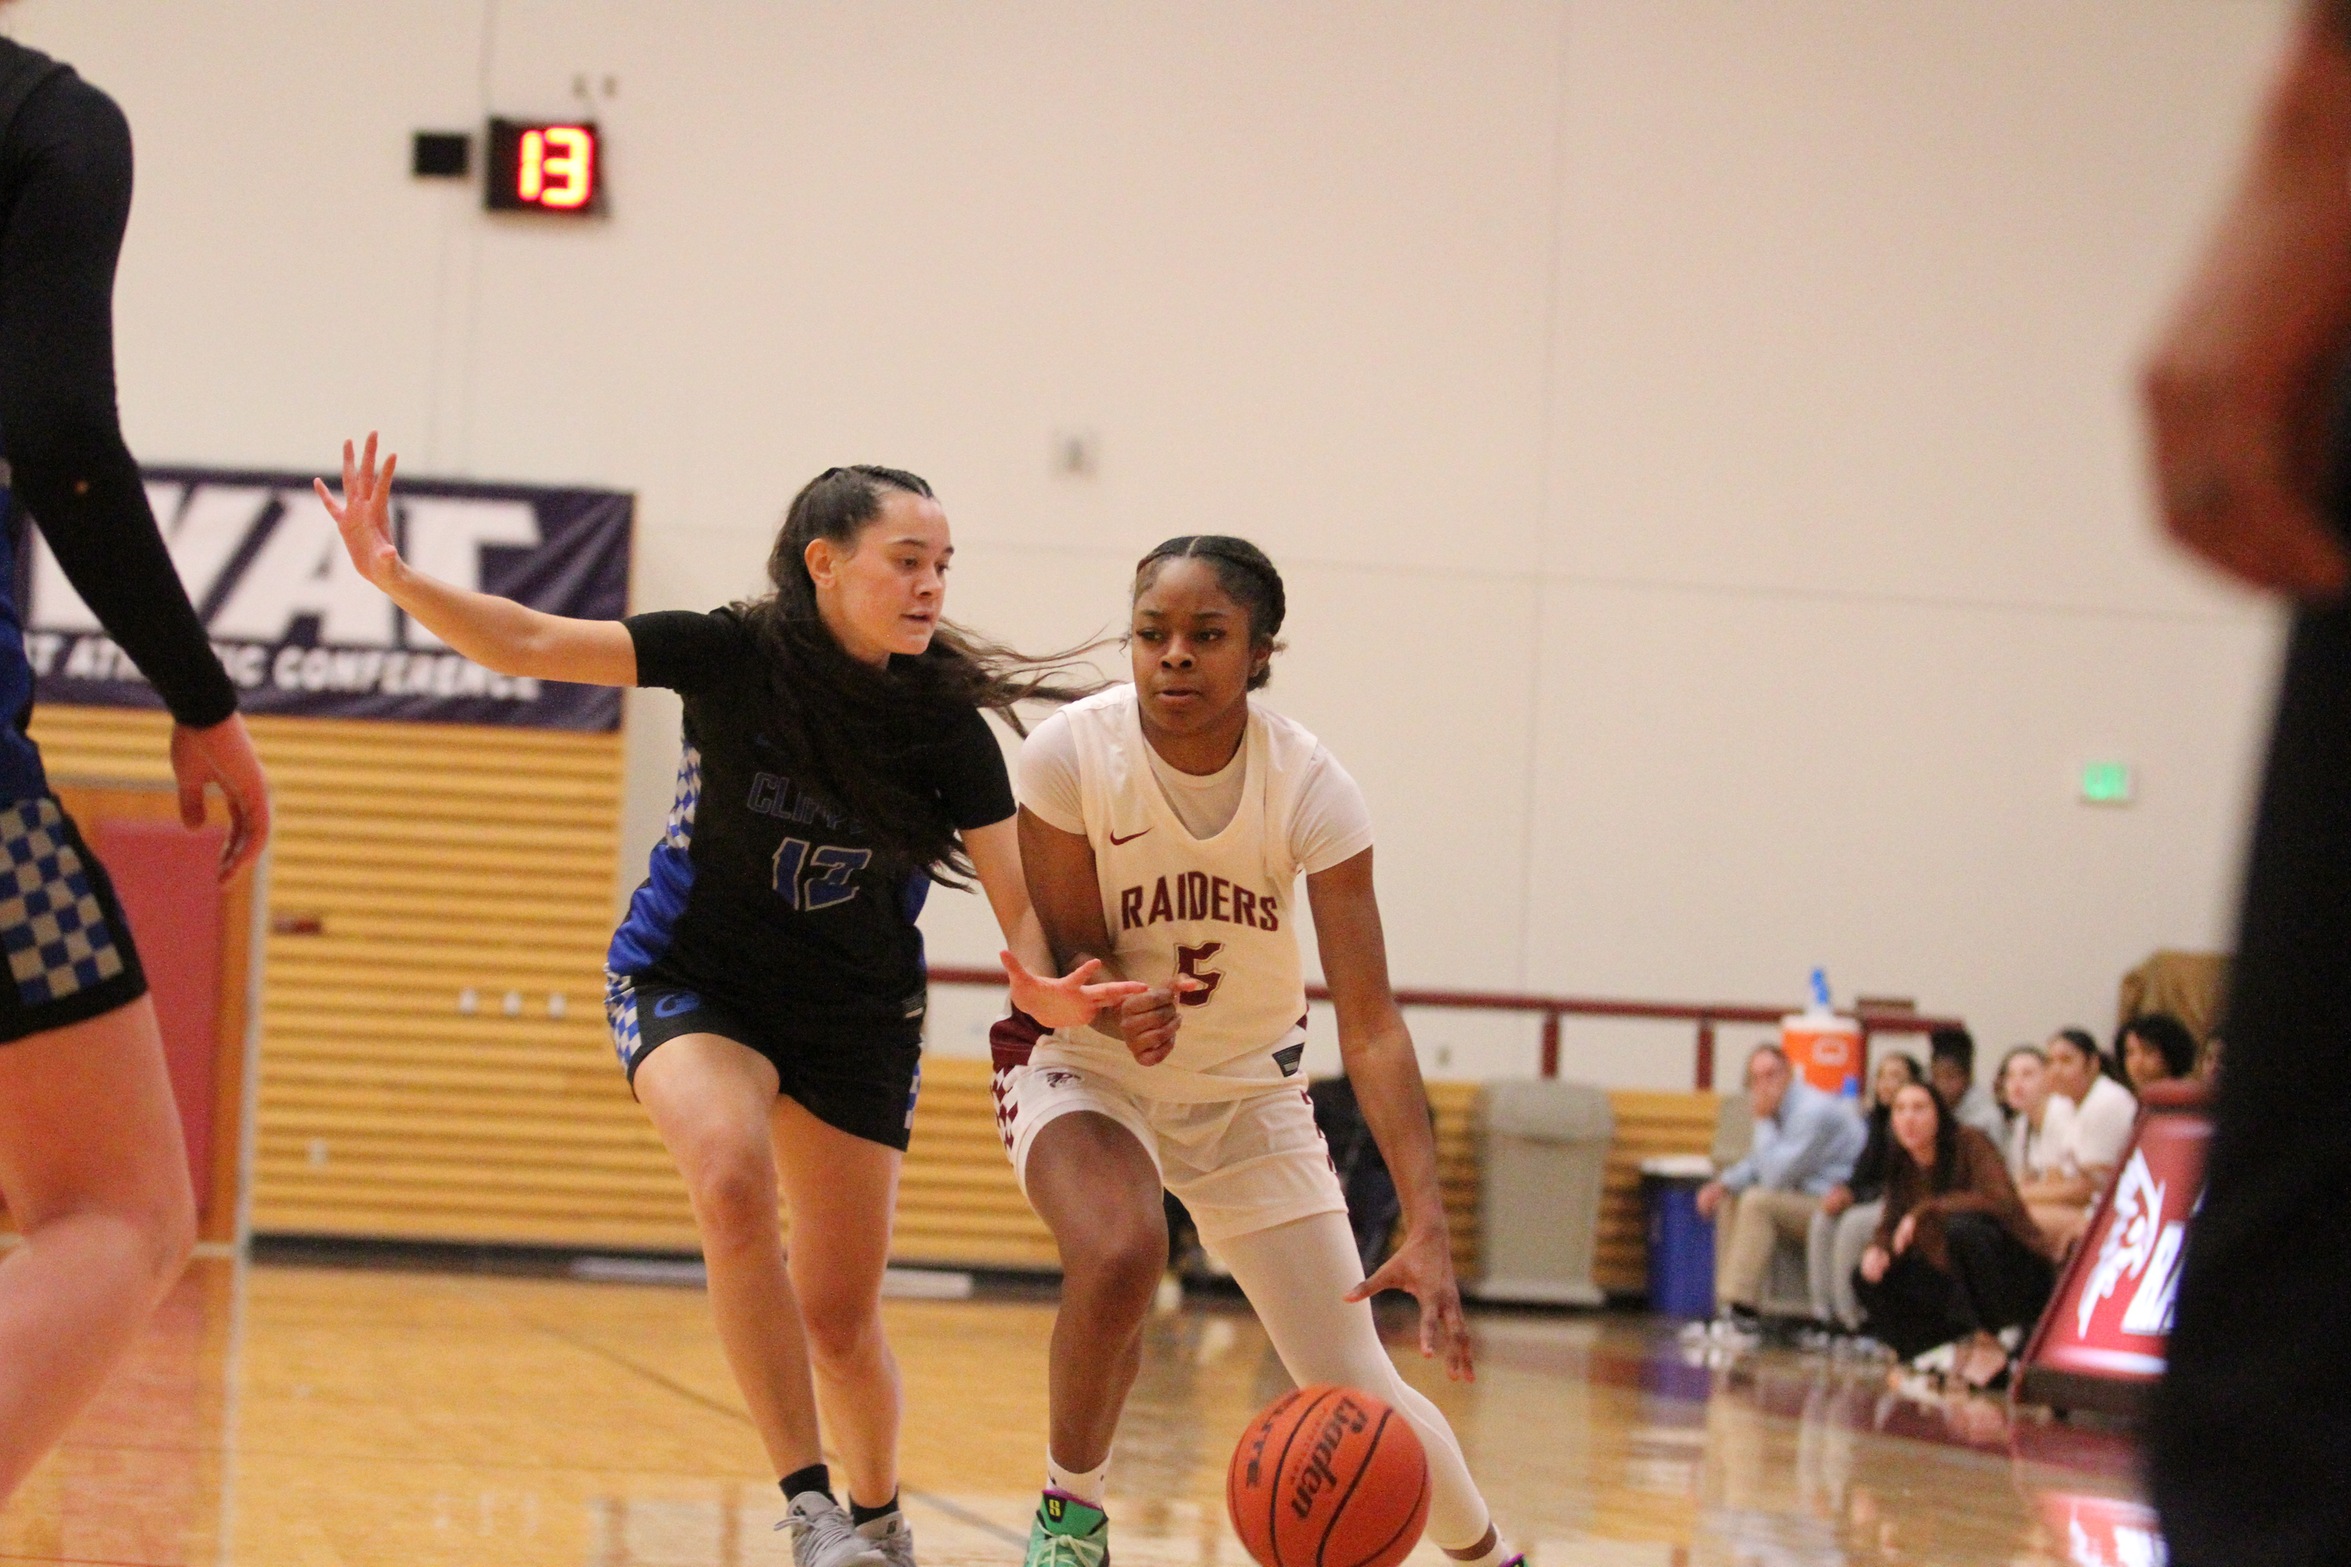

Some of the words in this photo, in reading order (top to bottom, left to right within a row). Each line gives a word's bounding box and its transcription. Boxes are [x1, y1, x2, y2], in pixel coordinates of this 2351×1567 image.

[518, 125, 594, 209] 13
[771, 836, 873, 912] 12
[1121, 870, 1279, 932] RAIDERS
[1173, 939, 1226, 1009] 5
